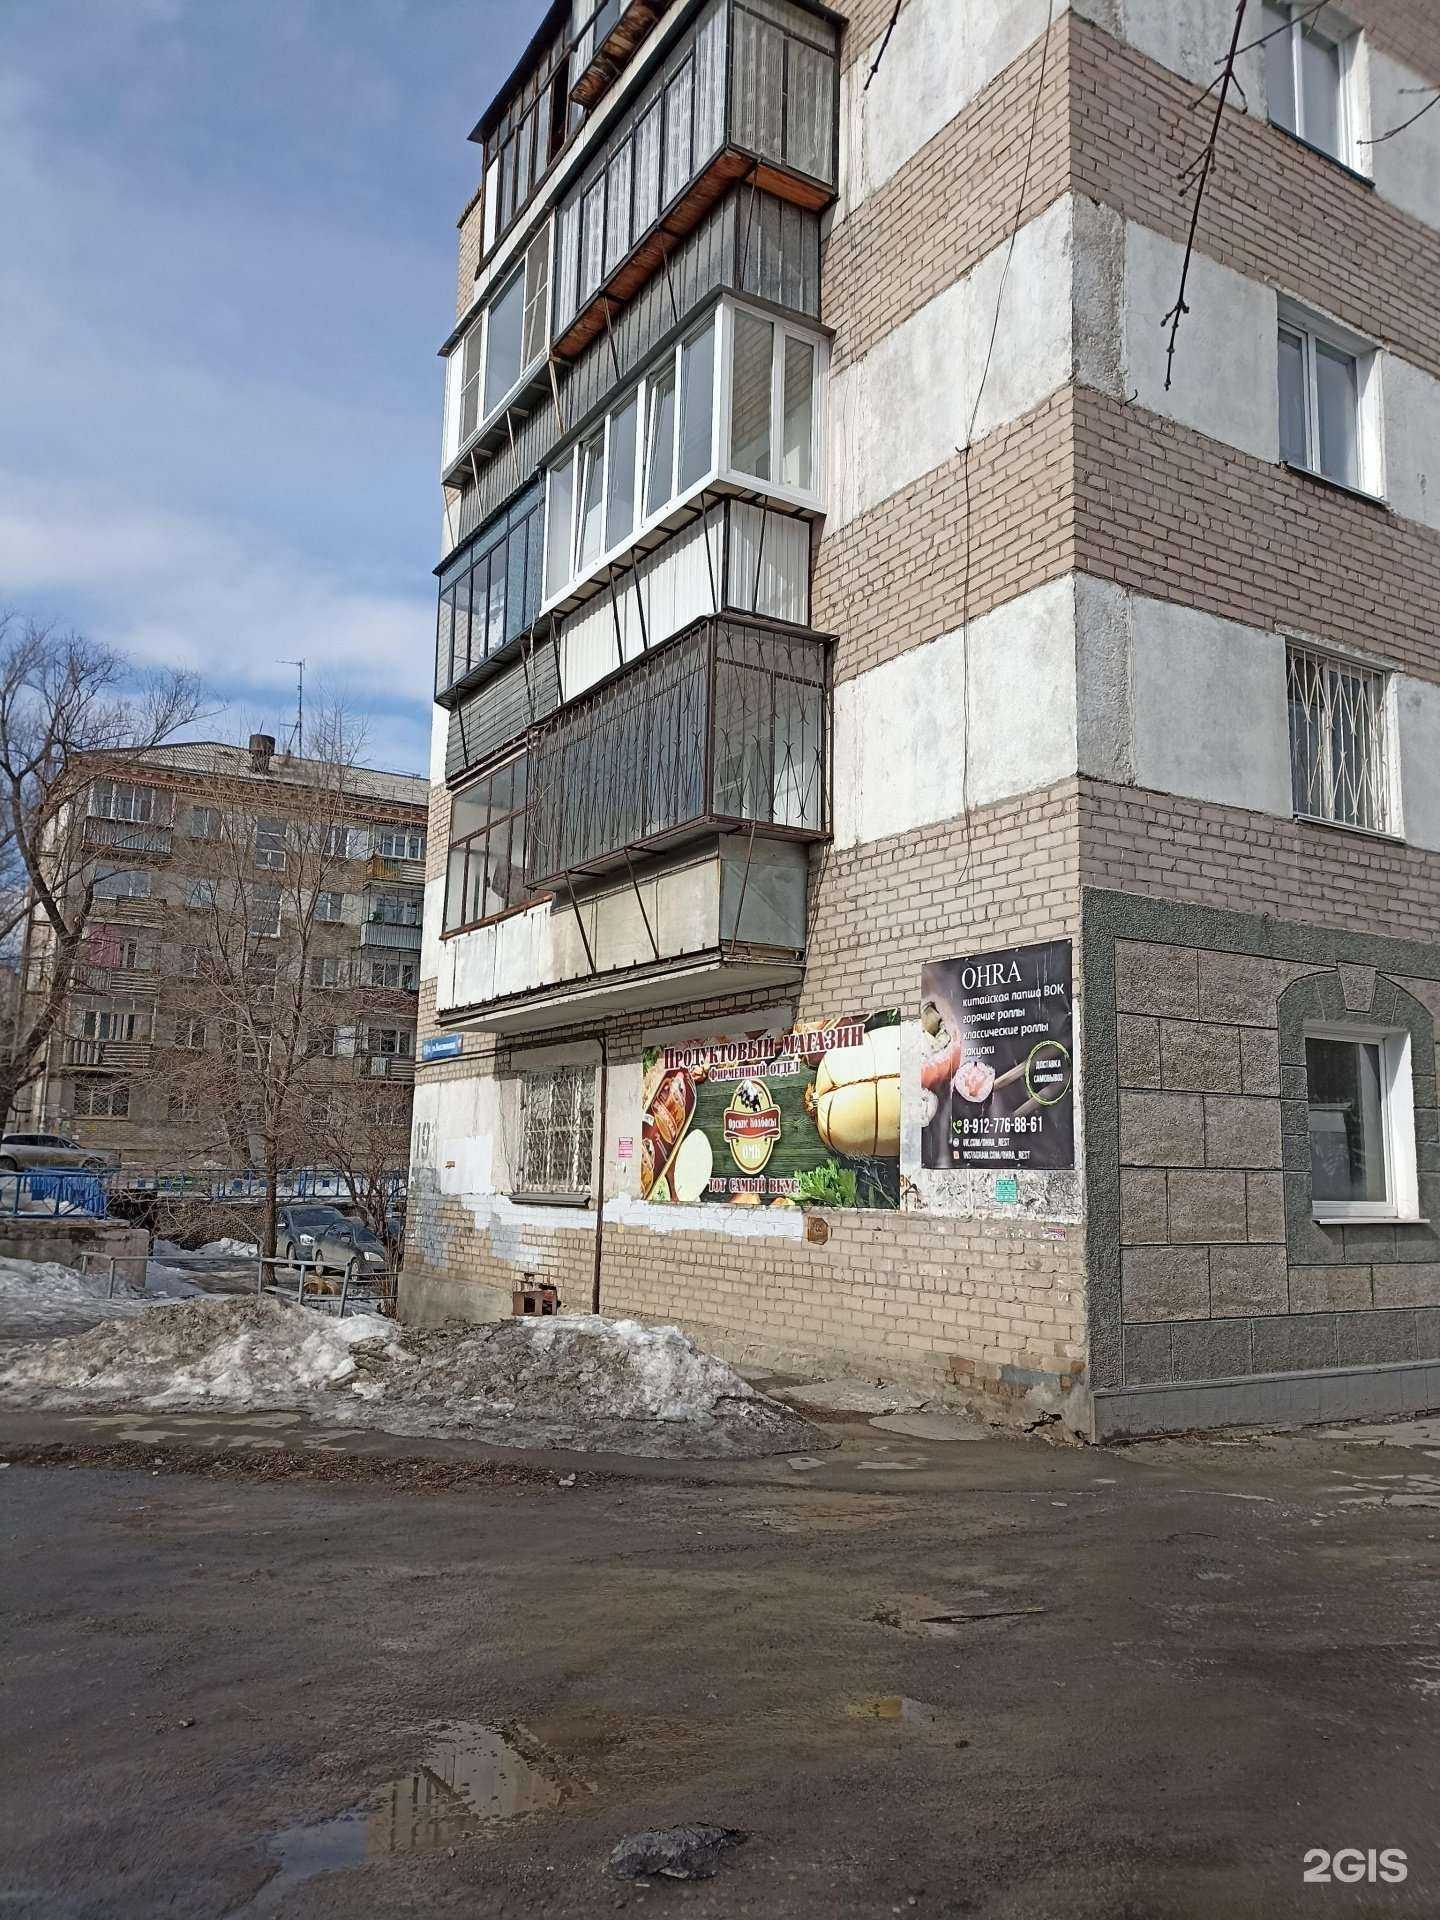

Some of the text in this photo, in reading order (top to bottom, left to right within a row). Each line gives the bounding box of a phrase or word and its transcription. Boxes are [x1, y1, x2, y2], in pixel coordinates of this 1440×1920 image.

[961, 961, 1022, 989] OHRA
[962, 983, 1065, 1008] китайская лапша ВОК
[962, 1008, 1026, 1025] горячие роллы
[781, 1024, 865, 1056] МАГАЗИН
[962, 1022, 1049, 1041] классические роллы
[769, 1060, 800, 1077] ОТДЕЛ
[963, 1116, 1043, 1134] 8-912-776-88-61
[708, 1178, 726, 1193] ТОТ
[729, 1175, 767, 1193] САМЫЙ
